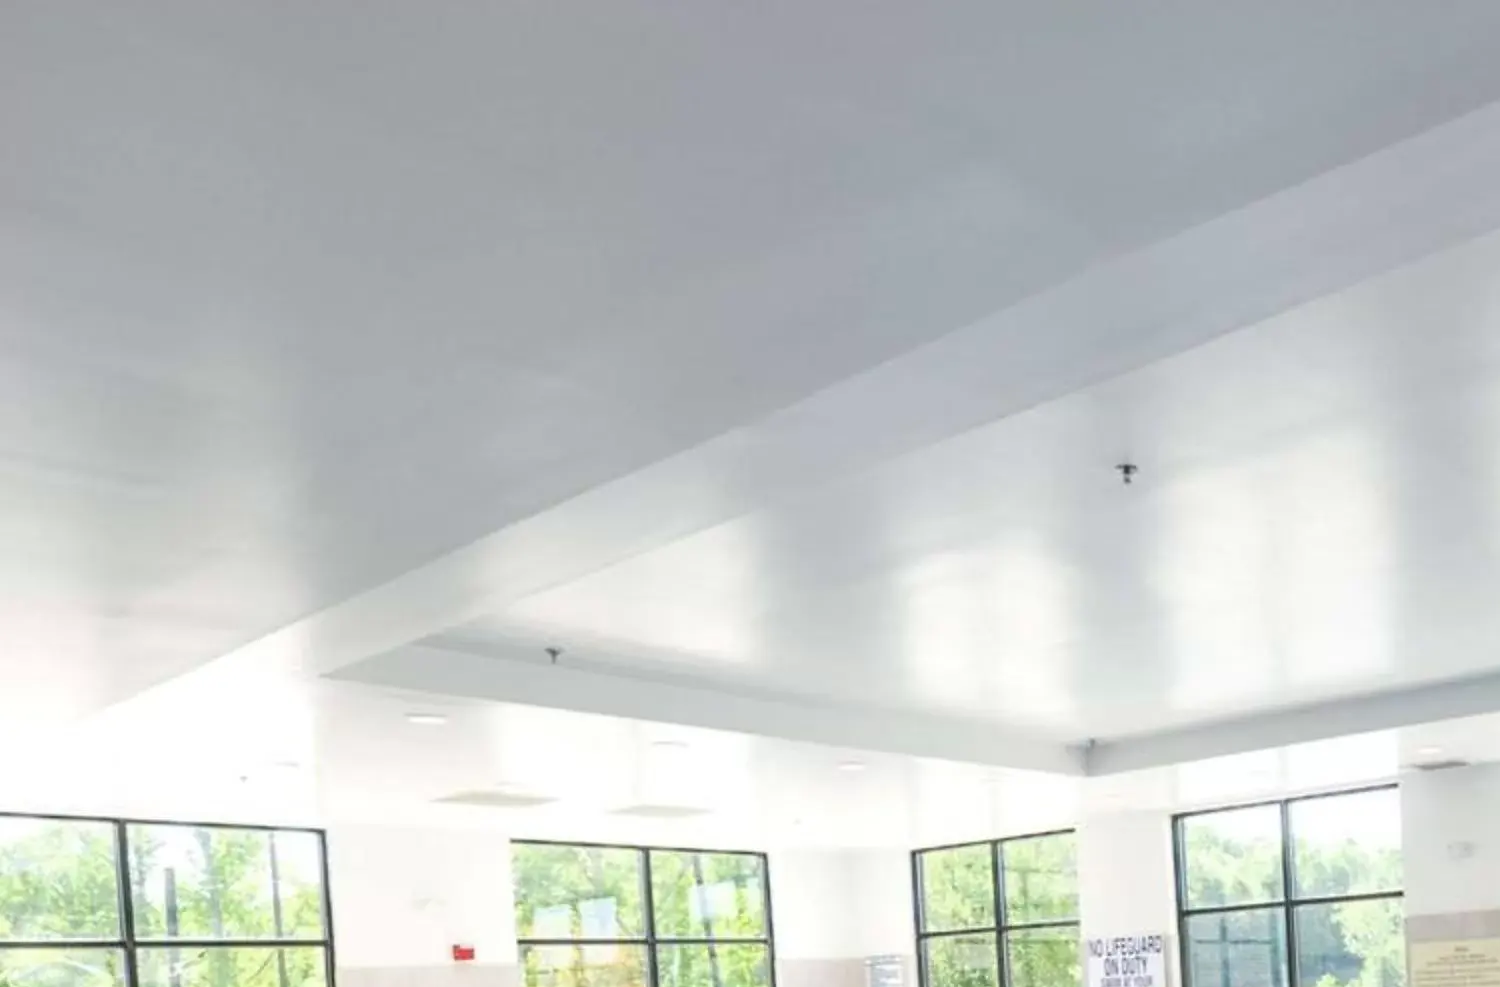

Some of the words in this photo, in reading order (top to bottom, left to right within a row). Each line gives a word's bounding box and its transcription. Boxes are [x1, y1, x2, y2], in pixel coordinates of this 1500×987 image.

[1088, 938, 1104, 957] NO
[1106, 935, 1162, 956] LIFEGUARD
[1104, 958, 1119, 976] ON
[1121, 956, 1147, 975] DUTY
